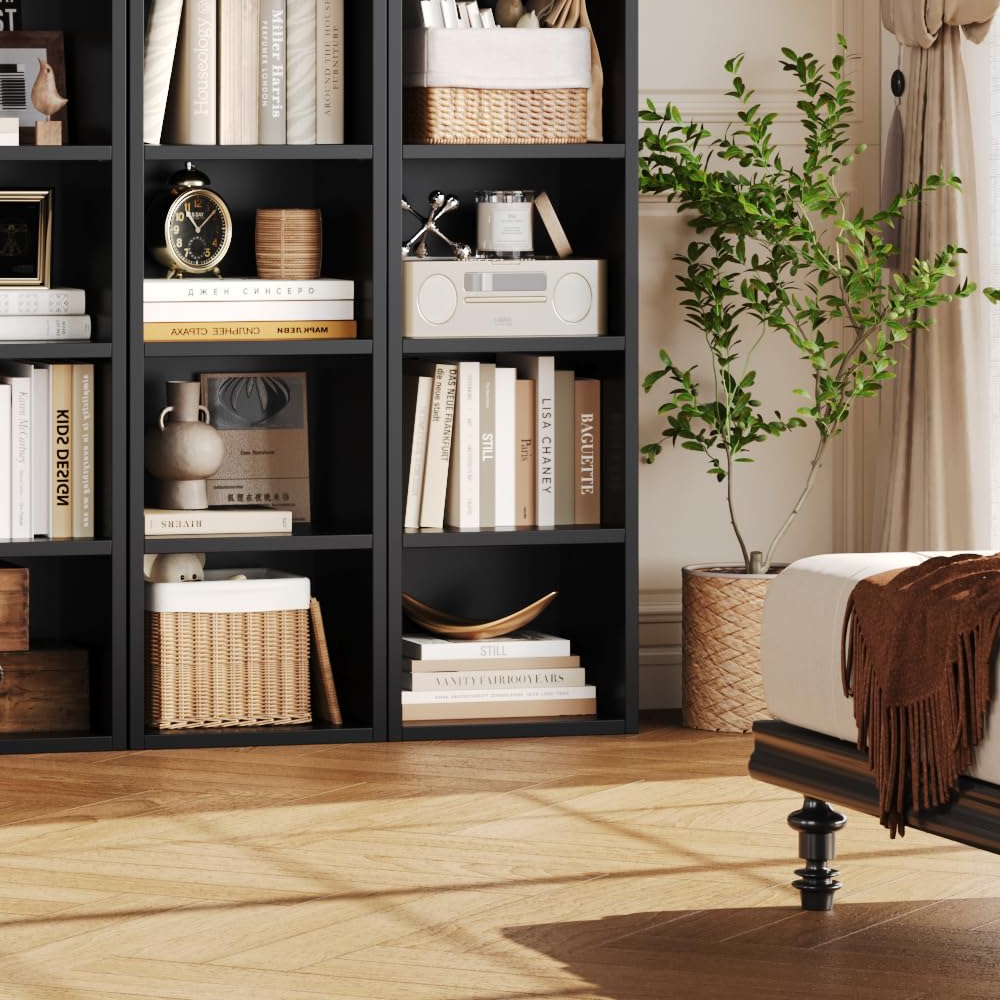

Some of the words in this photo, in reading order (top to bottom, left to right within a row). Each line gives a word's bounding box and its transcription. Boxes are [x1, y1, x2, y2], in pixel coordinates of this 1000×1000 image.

[272, 9, 284, 60] Miller
[194, 17, 213, 116] Houseology
[272, 63, 284, 118] Harris
[176, 212, 184, 222] 10
[173, 225, 180, 235] 9
[176, 238, 183, 248] 8
[212, 239, 218, 247] 4
[184, 248, 190, 258] 7
[204, 248, 211, 257] 5
[188, 288, 230, 297] ДЖЕН
[243, 287, 316, 296] СИНСЕРО
[436, 368, 444, 380] die
[448, 369, 457, 386] DAS
[445, 388, 455, 411] NEUE
[433, 403, 441, 422] stadt
[542, 399, 551, 429] LISA
[441, 414, 453, 462] FRANKFURT
[482, 433, 494, 462] STILL
[521, 439, 532, 462] Paris
[581, 413, 593, 495] BAGUETTE
[542, 436, 551, 494] CHANEY
[161, 520, 202, 528] RIVERS
[481, 645, 507, 656] STILL
[435, 675, 475, 686] VANITY
[481, 674, 505, 685] FAIR
[528, 673, 565, 684] YEARS
